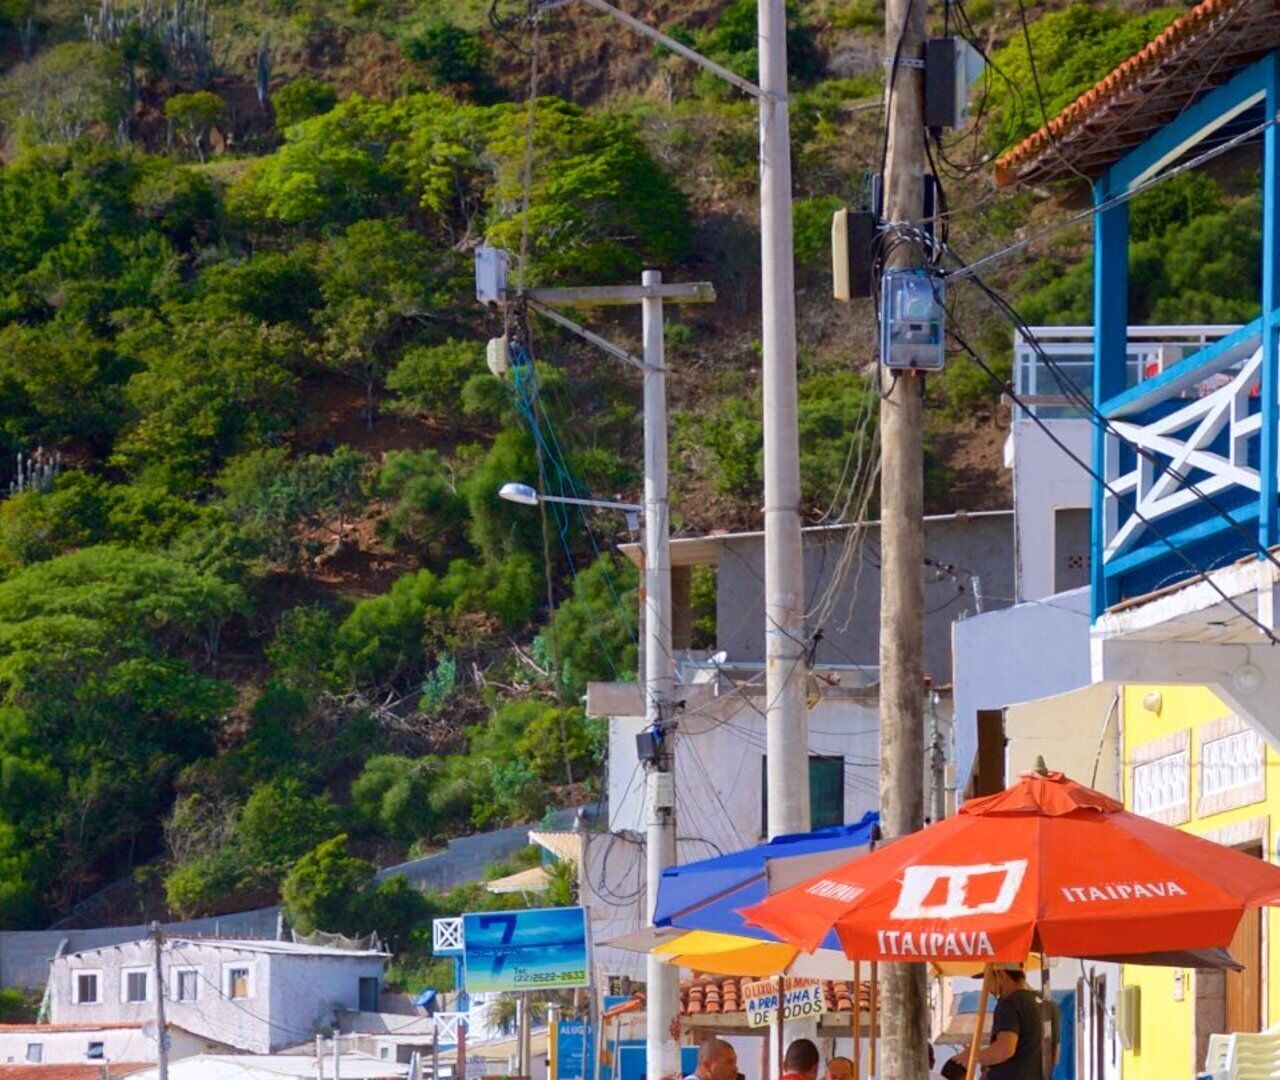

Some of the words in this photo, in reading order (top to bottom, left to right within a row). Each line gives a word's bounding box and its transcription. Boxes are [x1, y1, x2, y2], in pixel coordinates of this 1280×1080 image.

[1061, 881, 1188, 902] ITAIPAVA
[877, 929, 996, 956] ITAIPAVA
[758, 989, 810, 1009] PRANHA
[754, 1010, 770, 1025] DE
